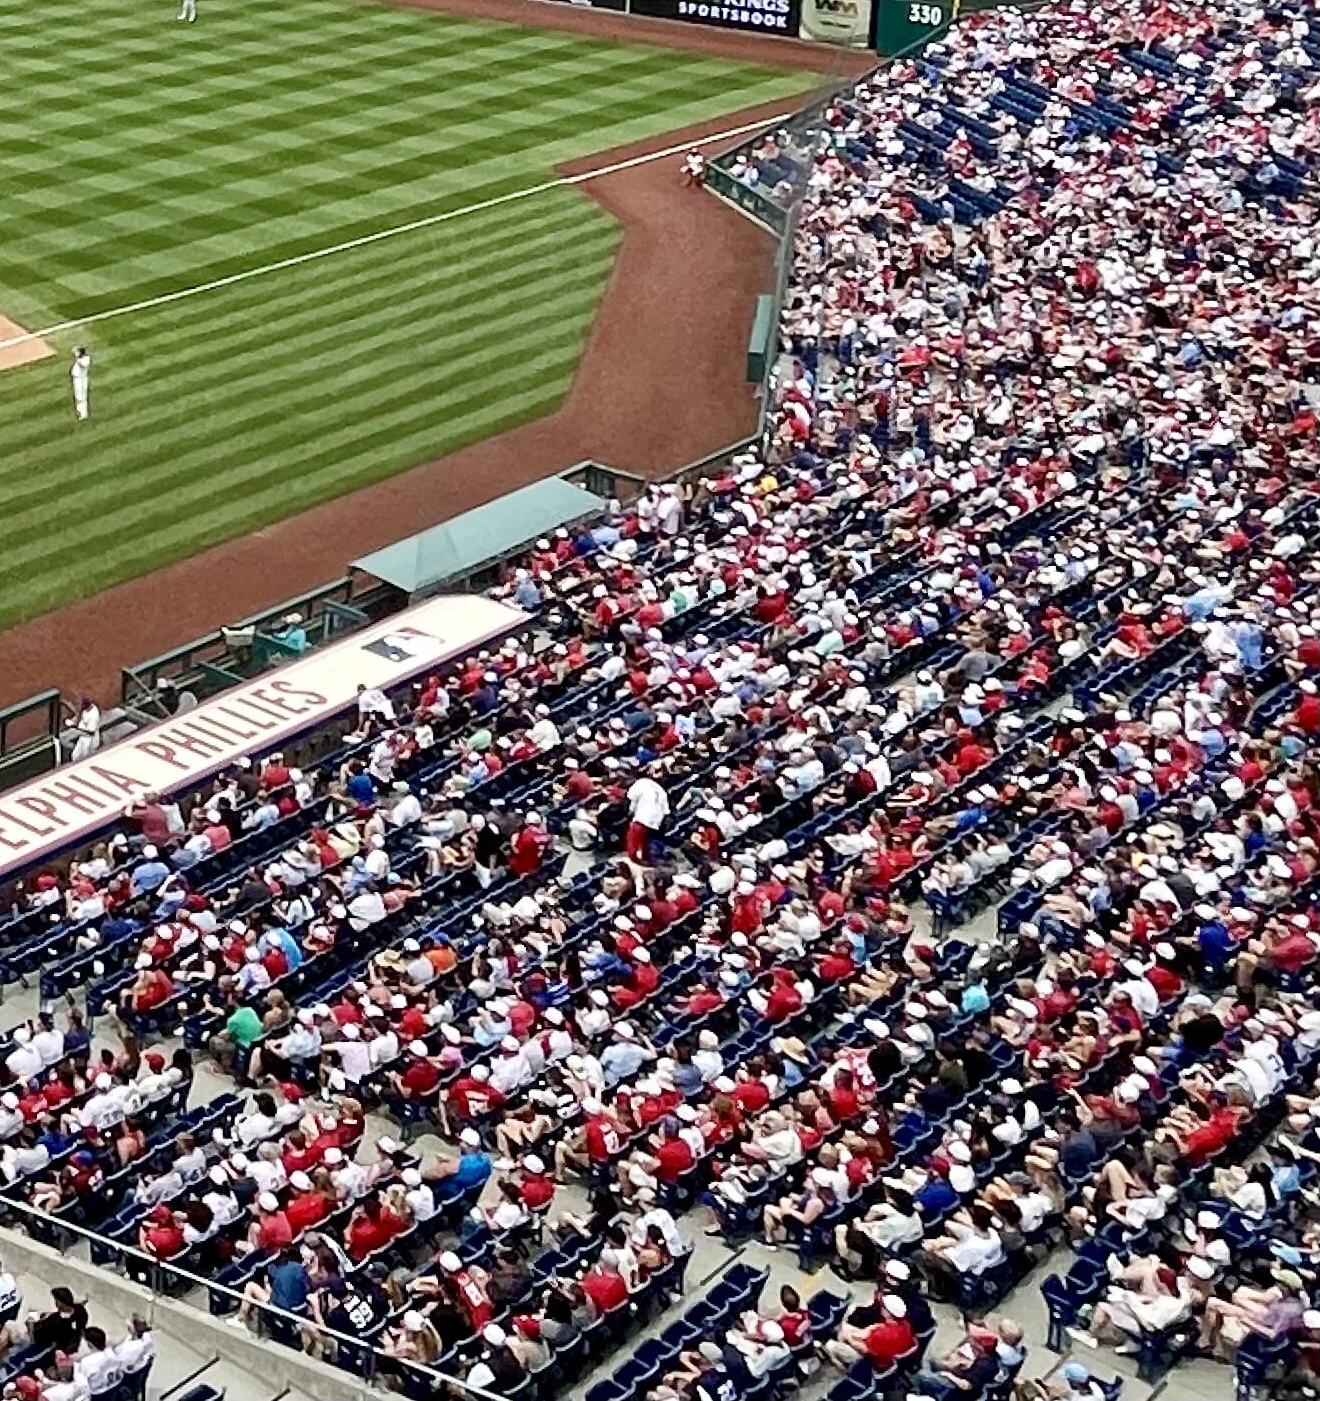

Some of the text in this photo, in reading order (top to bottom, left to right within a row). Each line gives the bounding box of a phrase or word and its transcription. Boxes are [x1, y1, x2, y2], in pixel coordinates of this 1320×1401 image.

[678, 0, 788, 29] SPORTSBOOK
[909, 3, 942, 26] 330
[134, 679, 328, 770] PHILLIES
